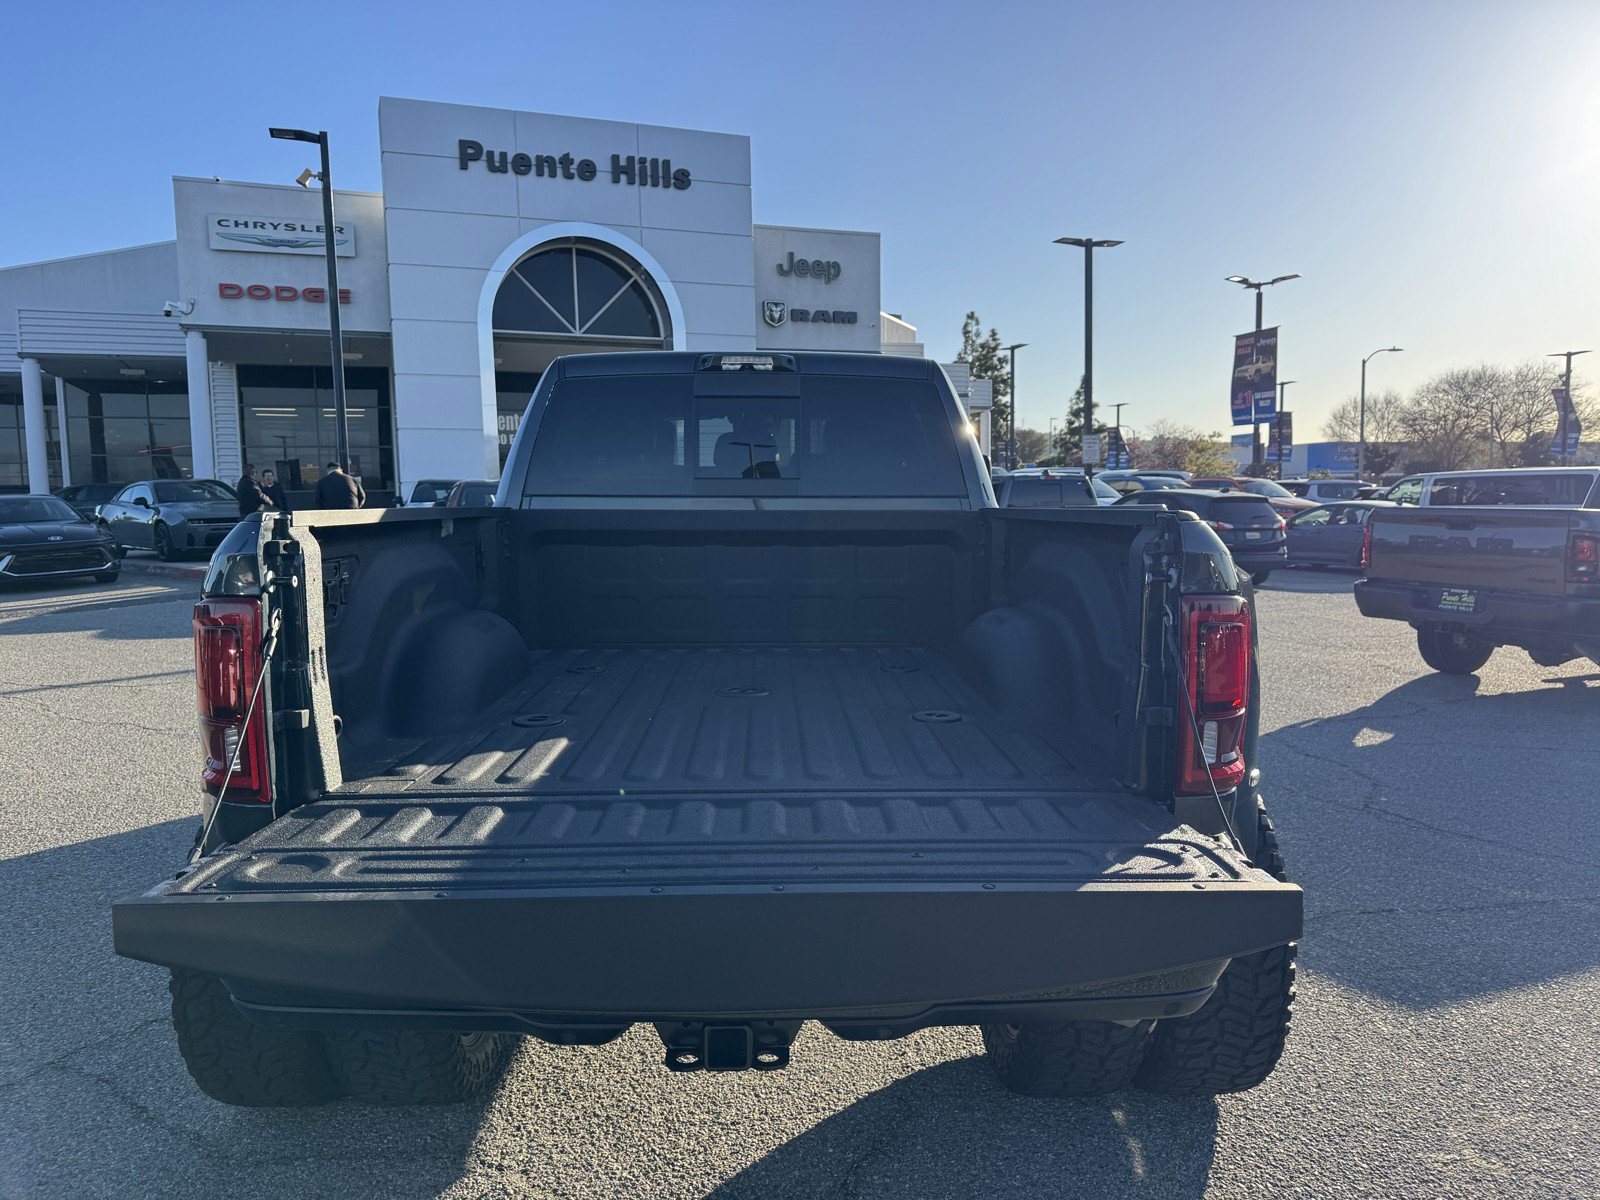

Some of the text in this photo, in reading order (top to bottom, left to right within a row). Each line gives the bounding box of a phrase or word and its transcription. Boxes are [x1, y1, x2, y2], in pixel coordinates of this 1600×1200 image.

[458, 138, 691, 190] Puente Hills
[216, 218, 345, 234] CHRYSLER
[776, 251, 841, 285] Jeep
[790, 308, 858, 324] RAM
[1256, 337, 1276, 347] Jeep
